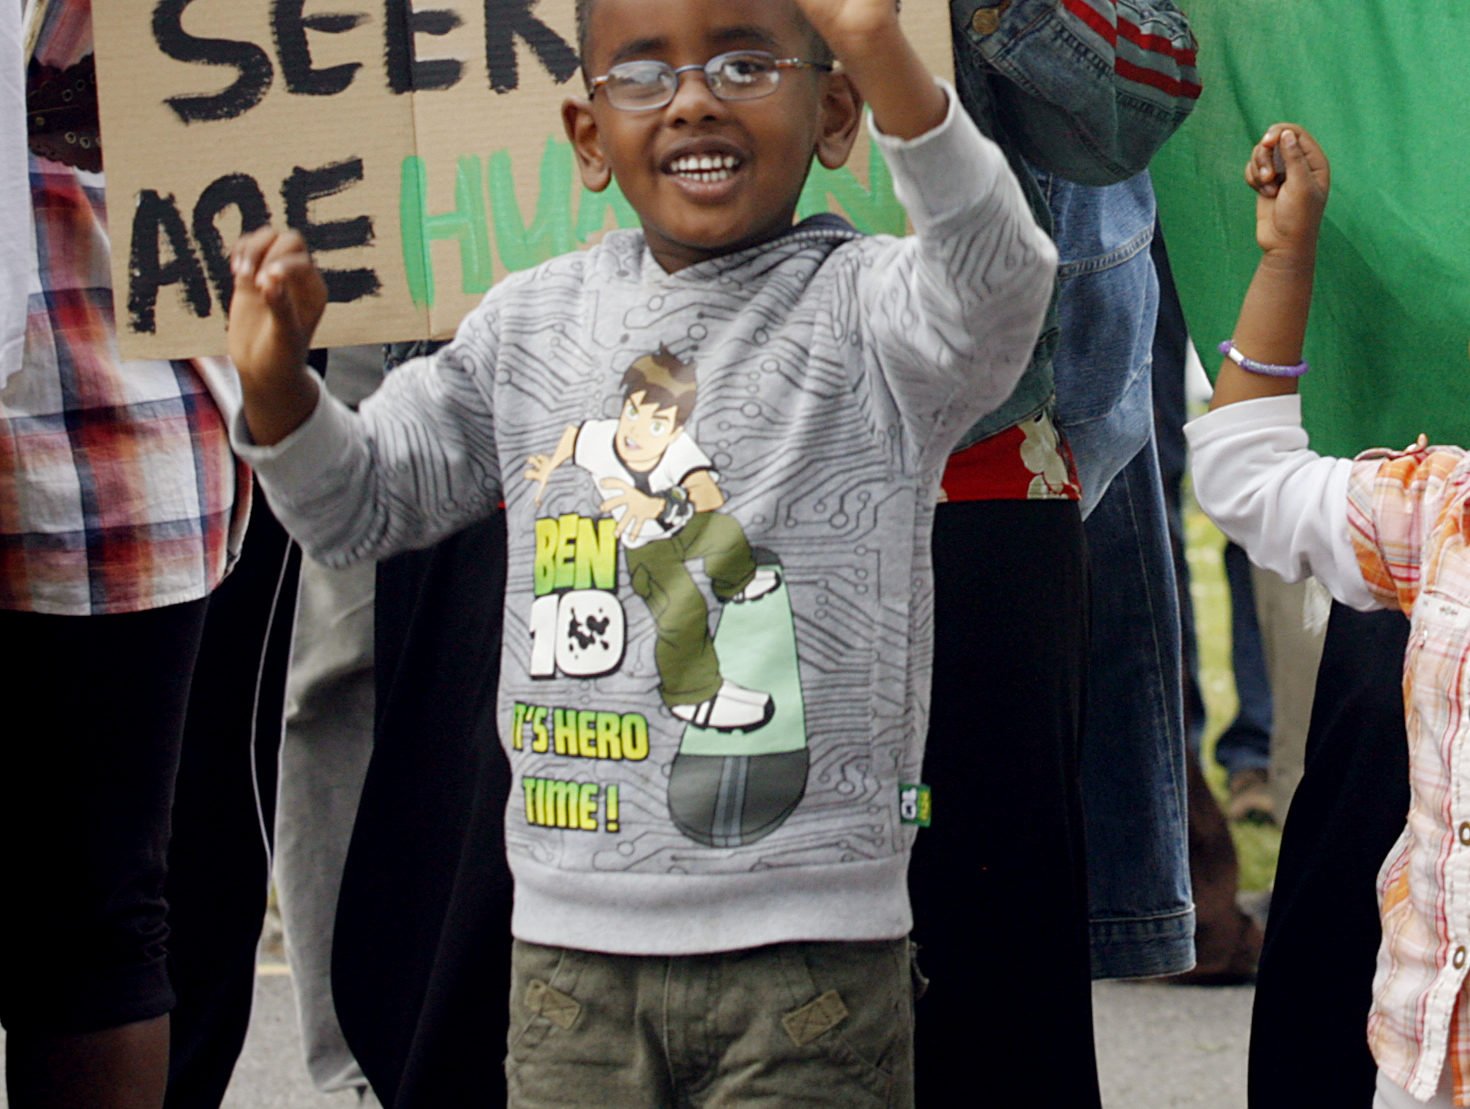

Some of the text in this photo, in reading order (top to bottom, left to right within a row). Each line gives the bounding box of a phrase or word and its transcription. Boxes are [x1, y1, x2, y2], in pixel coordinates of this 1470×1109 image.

[127, 100, 907, 335] ARE HUN
[533, 512, 619, 596] BEN
[528, 588, 628, 681] 10
[552, 705, 650, 762] HERO
